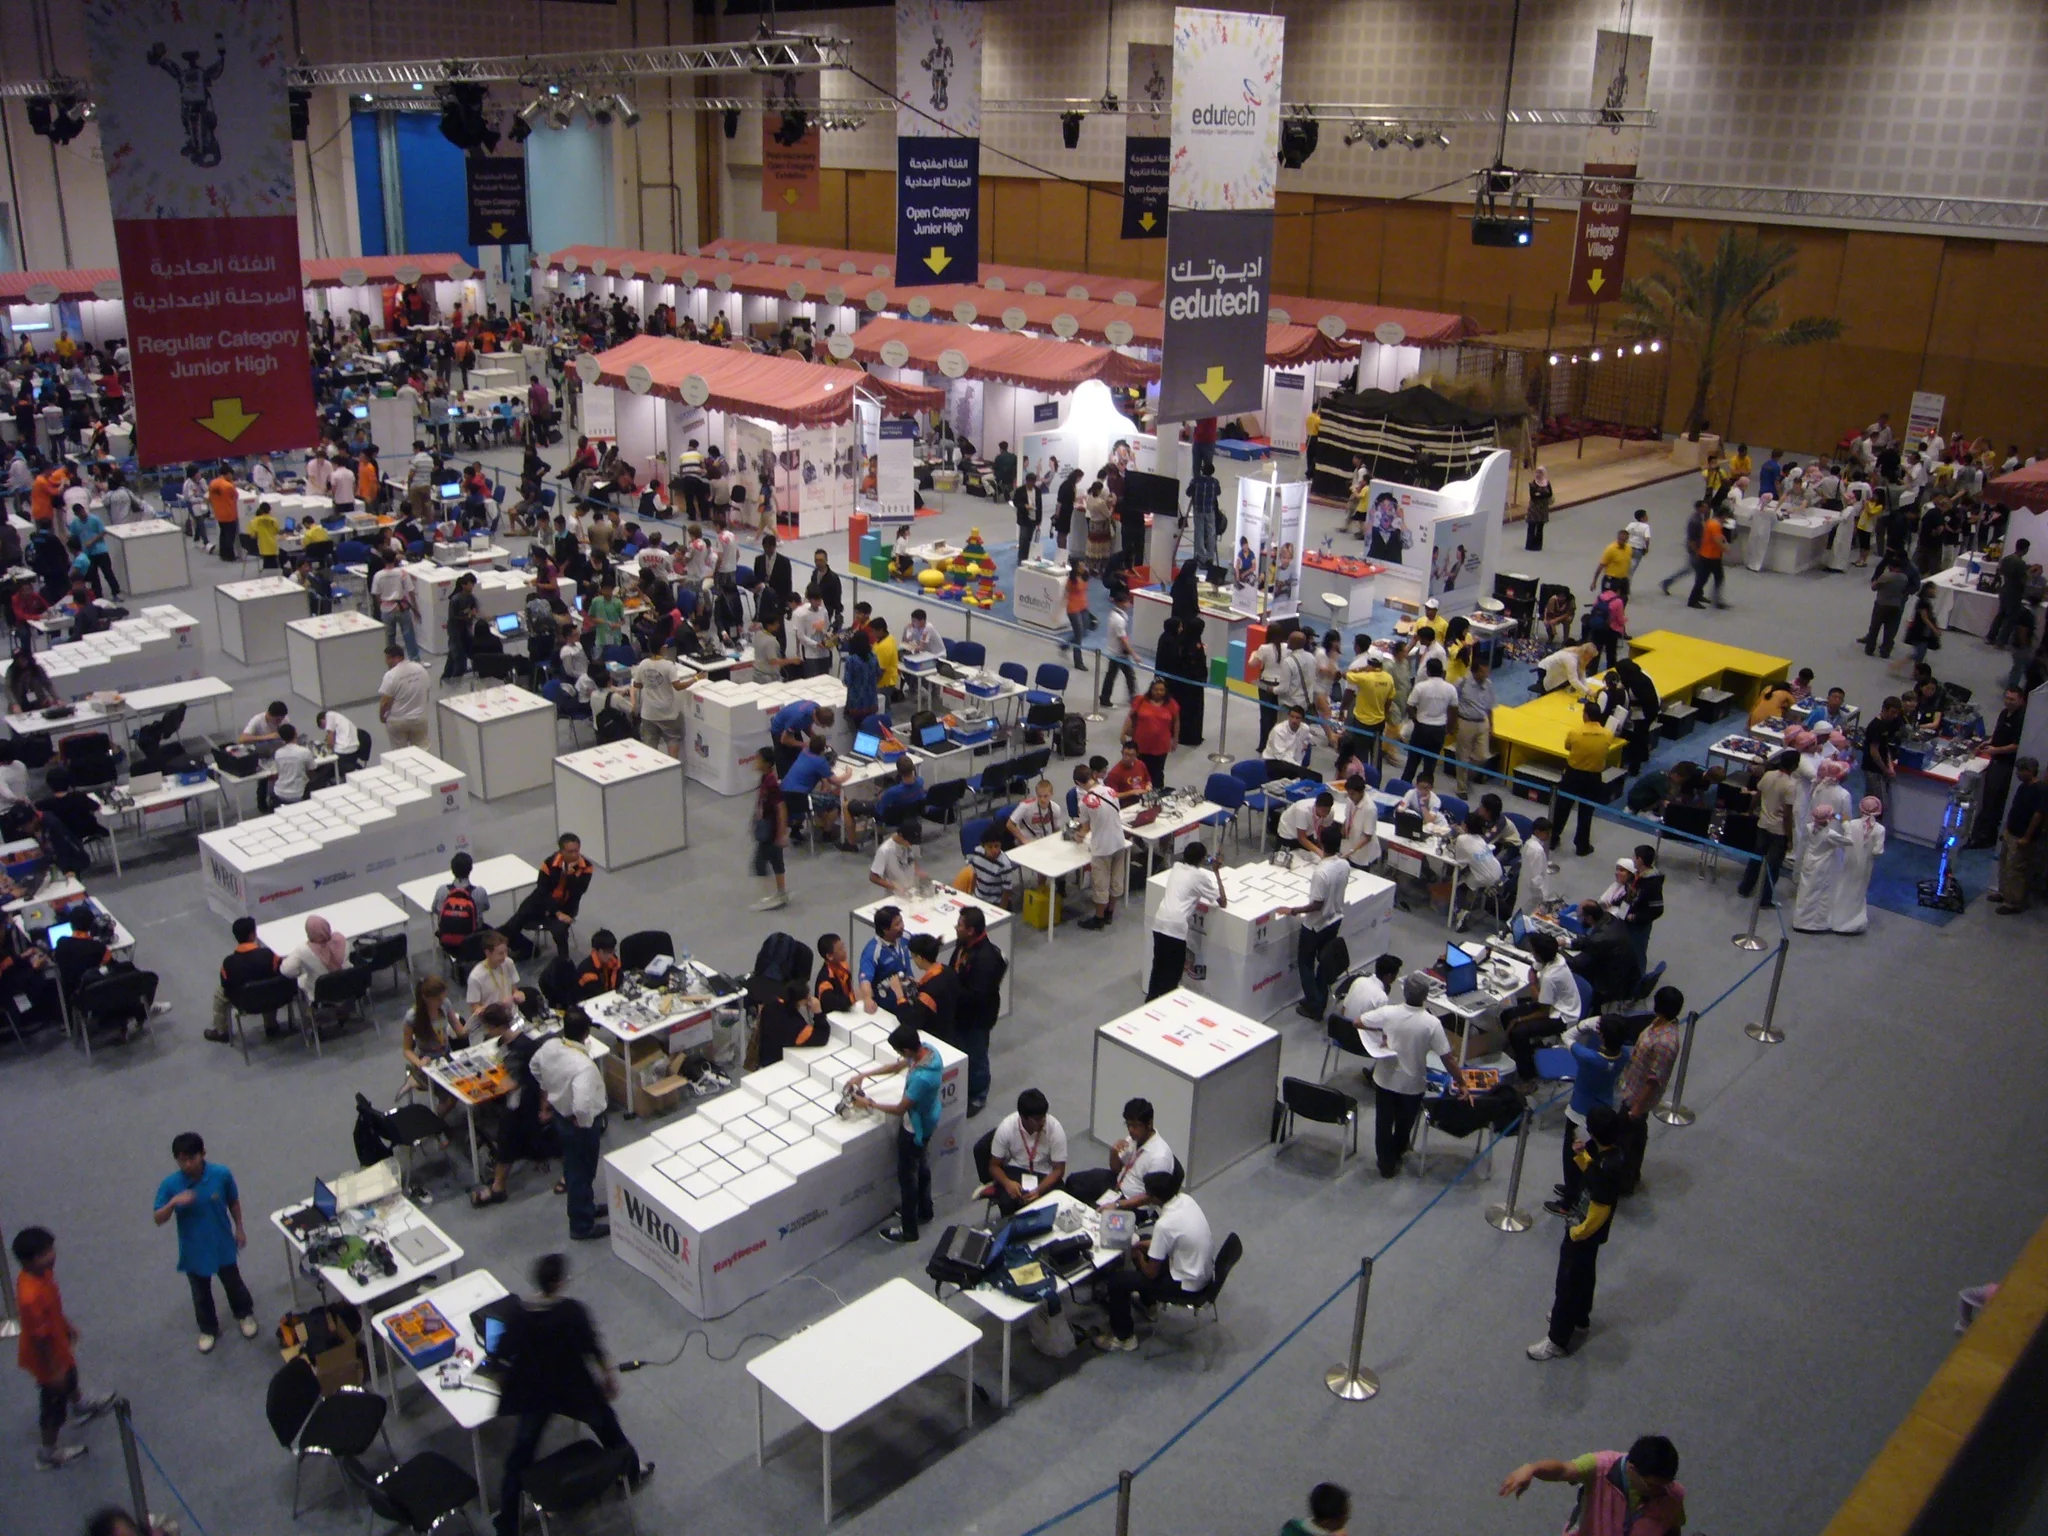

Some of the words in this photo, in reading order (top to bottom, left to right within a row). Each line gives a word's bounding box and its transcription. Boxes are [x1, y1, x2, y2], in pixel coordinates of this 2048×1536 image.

[1192, 103, 1256, 126] edutech
[909, 156, 947, 171] المفتوحة
[948, 157, 969, 169] الفئة
[905, 175, 940, 191] الإعدادية
[941, 175, 972, 188] المرحلة
[1129, 185, 1145, 195] Open
[1146, 185, 1169, 195] Categor
[906, 206, 931, 221] Open
[932, 205, 970, 220] Category
[913, 222, 942, 236] Junior
[943, 221, 963, 236] High
[1585, 223, 1619, 242] Heritage
[1588, 241, 1614, 260] Village
[150, 256, 224, 280] العادية
[227, 254, 276, 273] الفئة
[133, 291, 220, 314] الإعدادية
[225, 285, 297, 306] المرحلة
[1170, 284, 1260, 321] edutech
[137, 333, 213, 356] Regular
[218, 329, 300, 349] Category
[170, 358, 231, 379] Junior
[235, 353, 278, 376] High
[210, 856, 239, 896] WRO
[1192, 912, 1204, 928] 11
[1257, 925, 1267, 940] 11
[941, 1083, 956, 1100] 10
[624, 1188, 680, 1256] WRO
[713, 1239, 767, 1274] Raytheon
